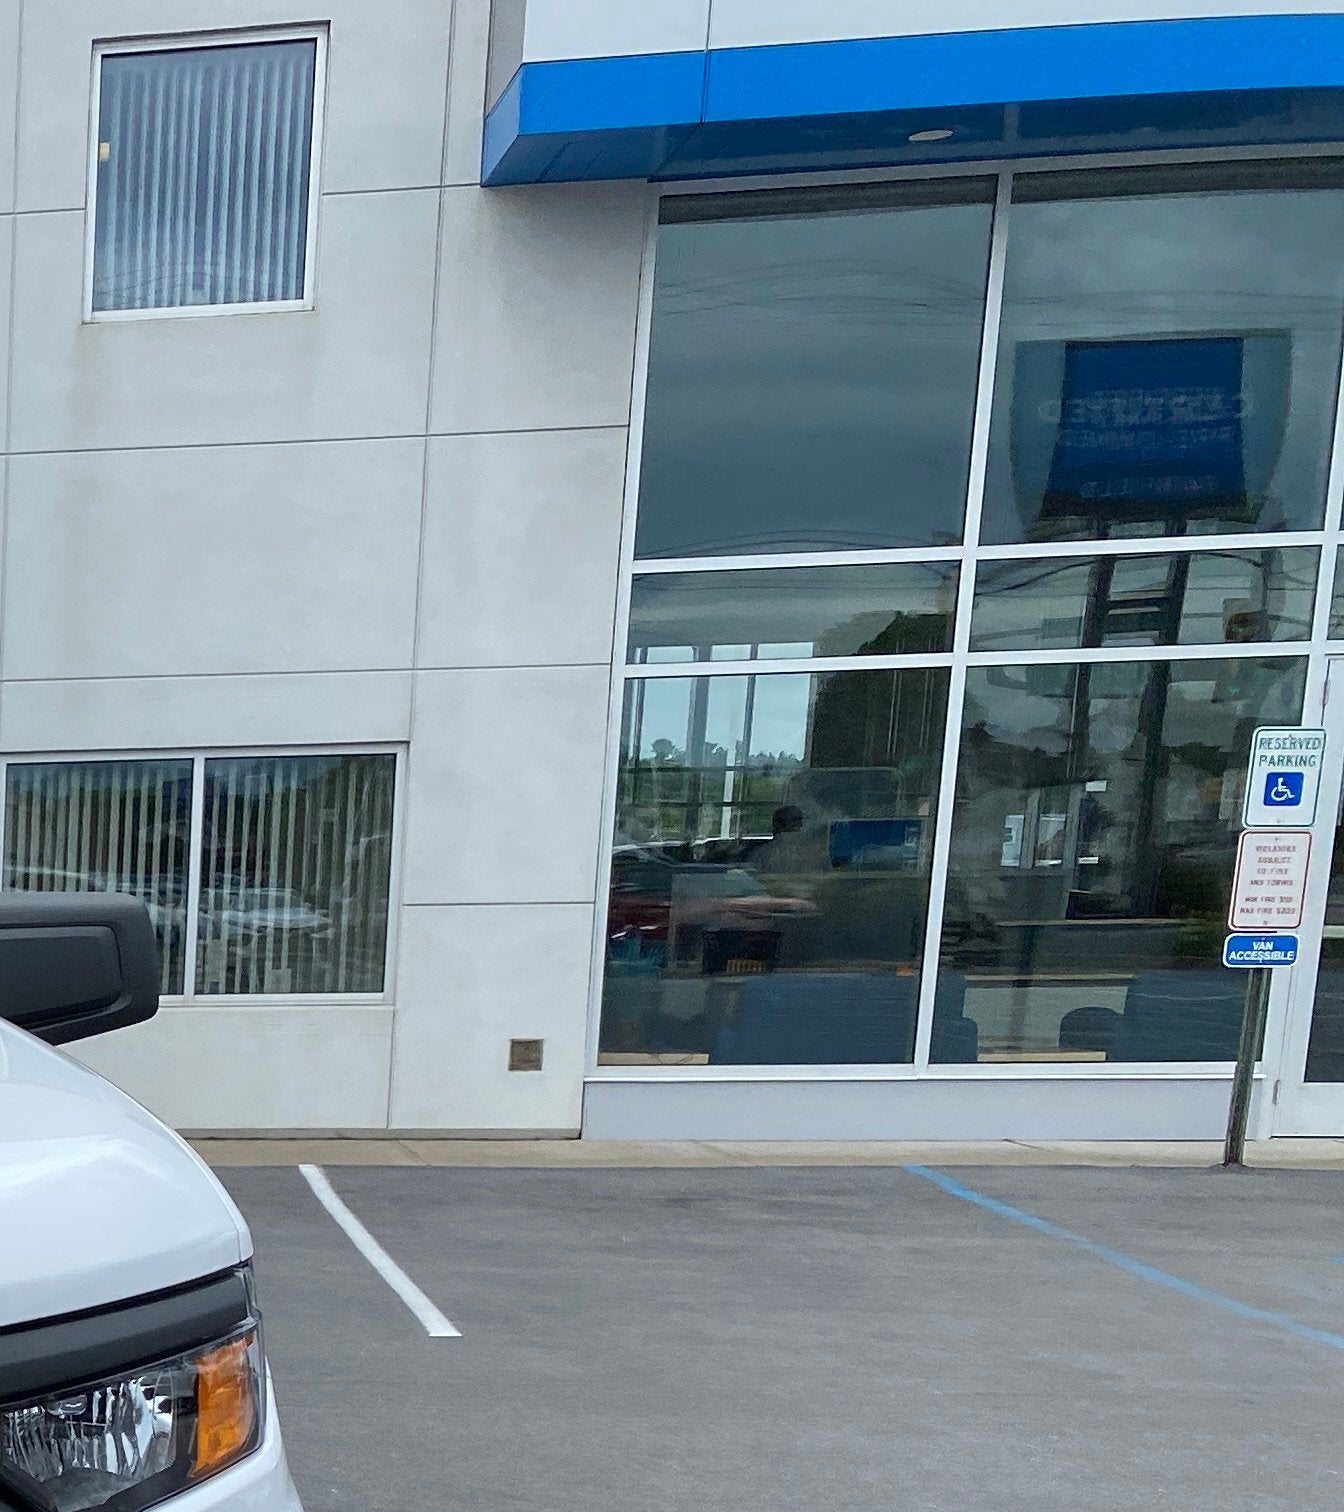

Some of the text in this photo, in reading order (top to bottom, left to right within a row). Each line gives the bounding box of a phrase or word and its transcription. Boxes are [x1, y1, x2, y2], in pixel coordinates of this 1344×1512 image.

[1258, 737, 1321, 750] RESERVED
[1258, 754, 1317, 767] PARKING
[1252, 941, 1273, 951] VAN
[1228, 950, 1295, 961] ACCESSIBLE
